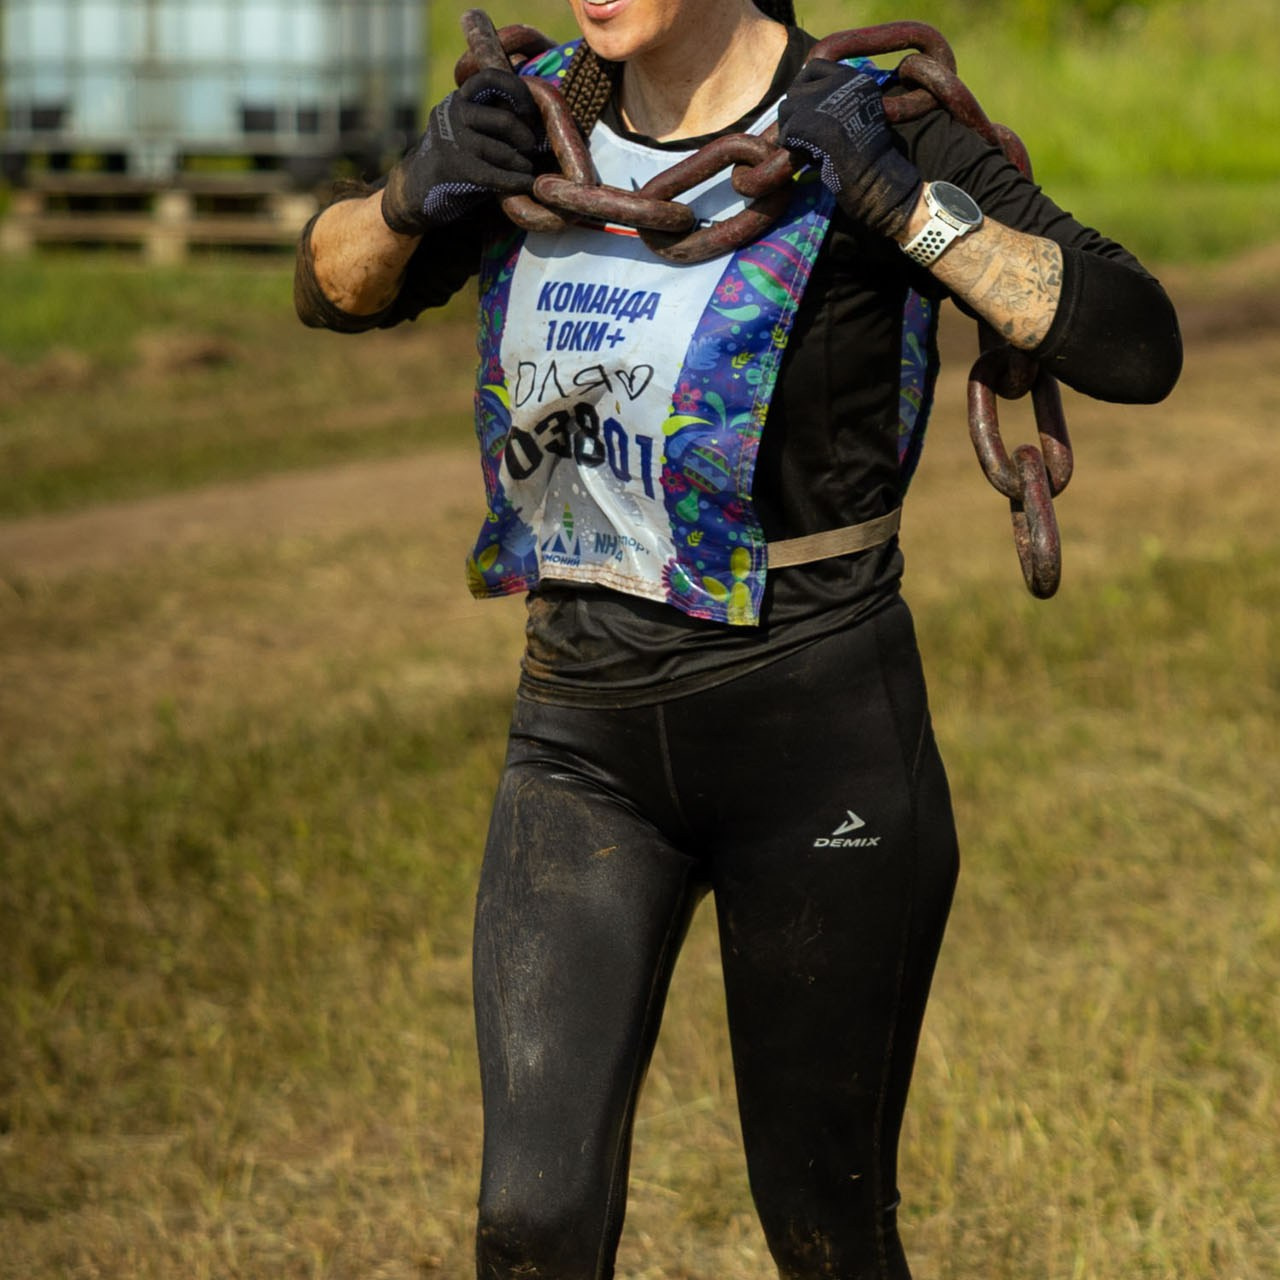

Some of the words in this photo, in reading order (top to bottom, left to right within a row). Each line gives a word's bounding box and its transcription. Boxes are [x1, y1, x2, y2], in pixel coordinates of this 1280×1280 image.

[536, 281, 662, 322] КОМАНДА
[546, 320, 626, 351] 10КМ+
[504, 402, 656, 501] 03801
[813, 836, 881, 848] DEMIX
